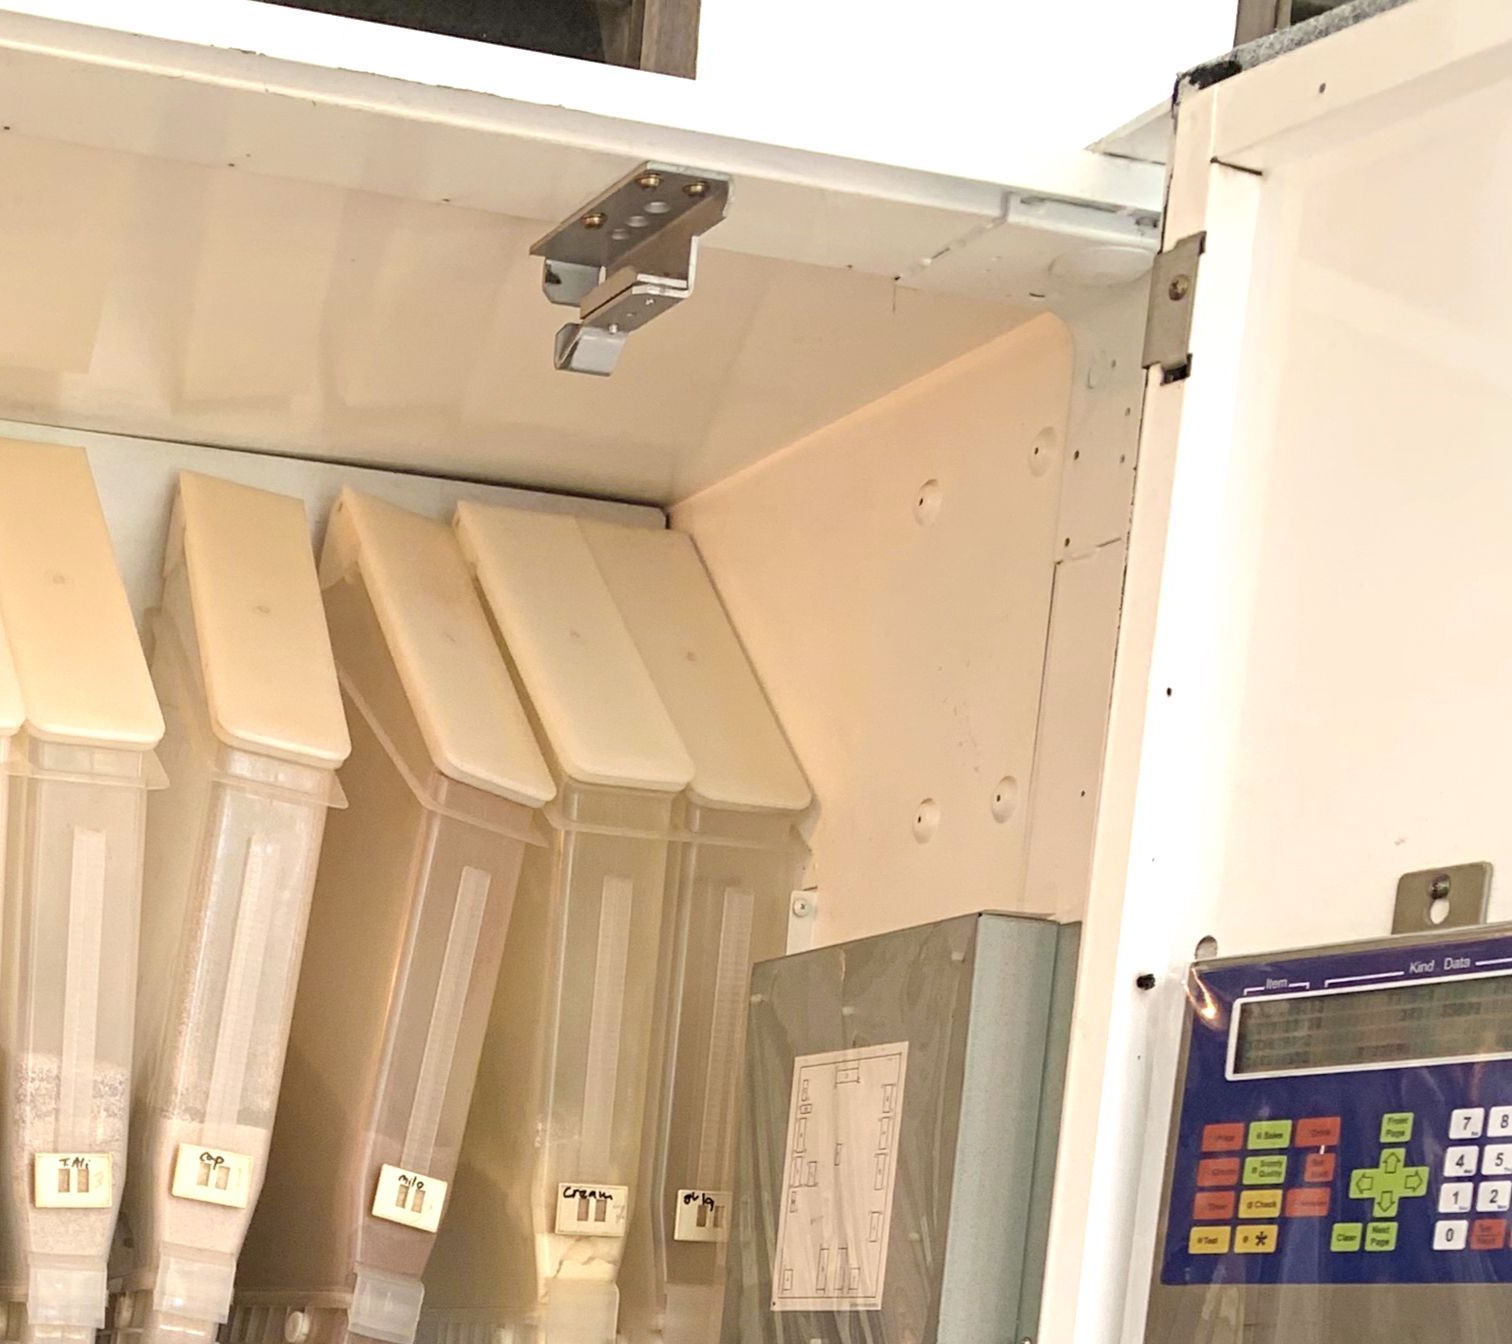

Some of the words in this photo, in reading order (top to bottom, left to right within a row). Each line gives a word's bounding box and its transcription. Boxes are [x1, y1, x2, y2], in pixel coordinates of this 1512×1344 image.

[1409, 960, 1436, 974] Kind
[1443, 957, 1472, 970] Data
[1265, 977, 1289, 989] Item
[1464, 1116, 1472, 1131] 7
[1500, 1115, 1509, 1128] 8
[1455, 1154, 1465, 1168] 4
[1495, 1153, 1504, 1167] 5
[1452, 1190, 1459, 1205] 1
[1489, 1189, 1498, 1204] 2
[1446, 1228, 1455, 1242] 0
